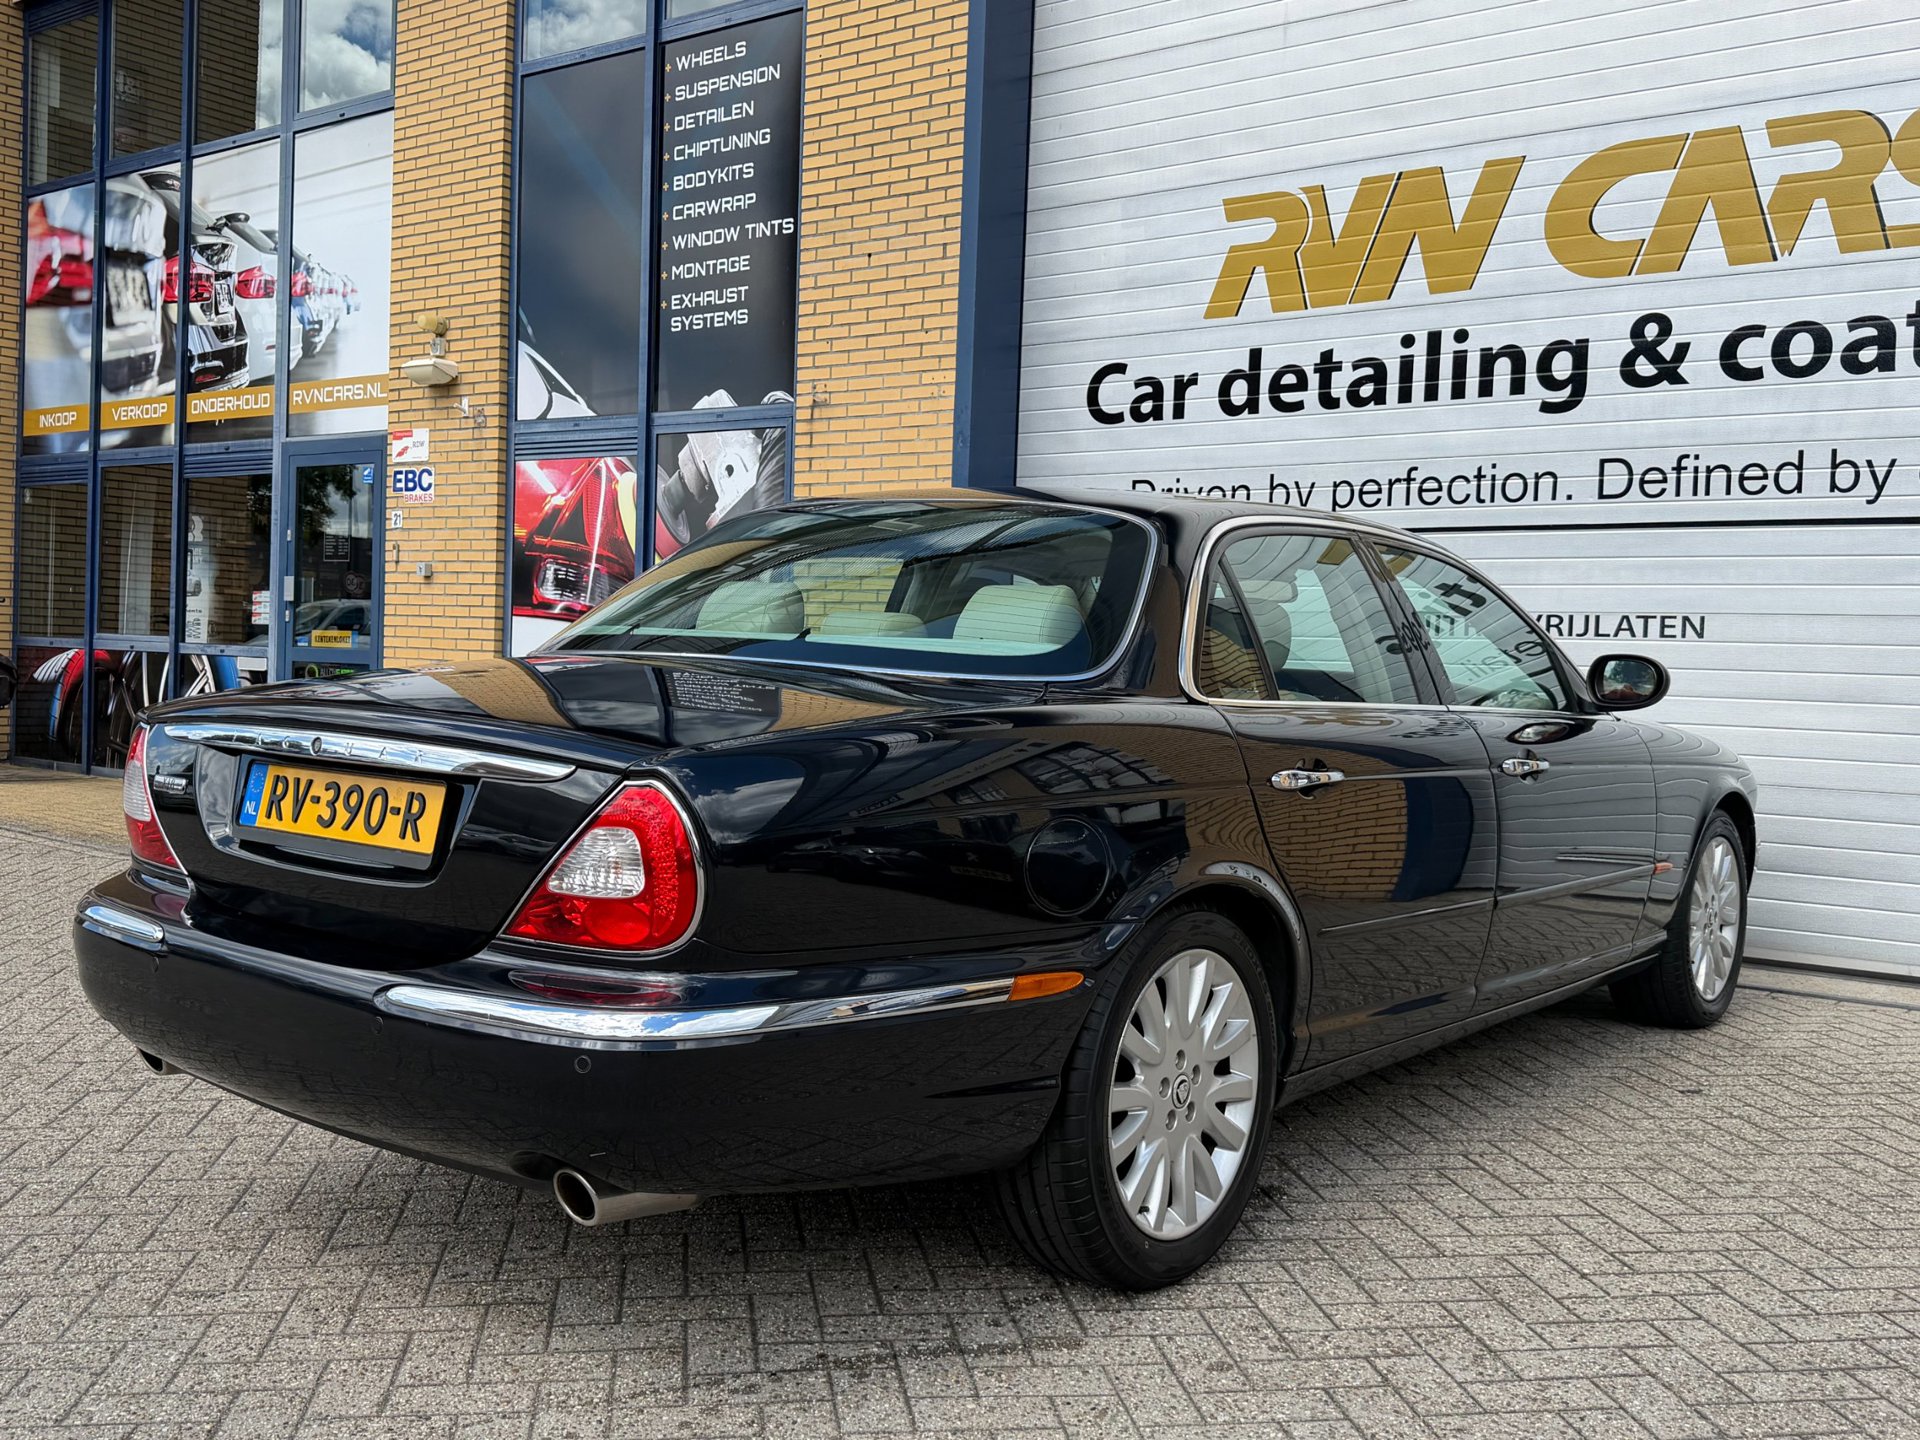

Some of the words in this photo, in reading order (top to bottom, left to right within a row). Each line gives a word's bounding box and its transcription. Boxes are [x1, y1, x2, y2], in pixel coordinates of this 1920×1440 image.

[676, 41, 747, 71] WHEELS
[674, 64, 781, 101] SUSPENSION
[674, 101, 754, 131] DETAILEN
[673, 128, 771, 162] CHIPTUNING
[673, 163, 755, 191] BODYKITS
[672, 193, 757, 221] CARWRAP
[672, 226, 740, 251] WINDOW
[745, 218, 794, 241] TINTS
[1203, 155, 1527, 320] RVN
[671, 255, 750, 281] MONTAGE
[671, 286, 749, 310] EXHAUST
[670, 309, 748, 332] SYSTEMS
[1087, 363, 1198, 424] Car
[1217, 328, 1590, 415] detailing
[1619, 312, 1691, 389] &
[191, 392, 270, 415] ONDERHOUD
[293, 383, 388, 406] RVNCARS.NL
[39, 411, 77, 428] INKOOP
[112, 402, 168, 421] VERKOOP
[392, 468, 433, 493] EBC
[1331, 463, 1574, 513] perfection.
[1597, 449, 1805, 500] Defined
[1829, 448, 1898, 505] by
[404, 493, 433, 502] BRAKES
[393, 512, 401, 526] 21
[244, 800, 257, 816] NL
[265, 774, 426, 842] RV-390-R
